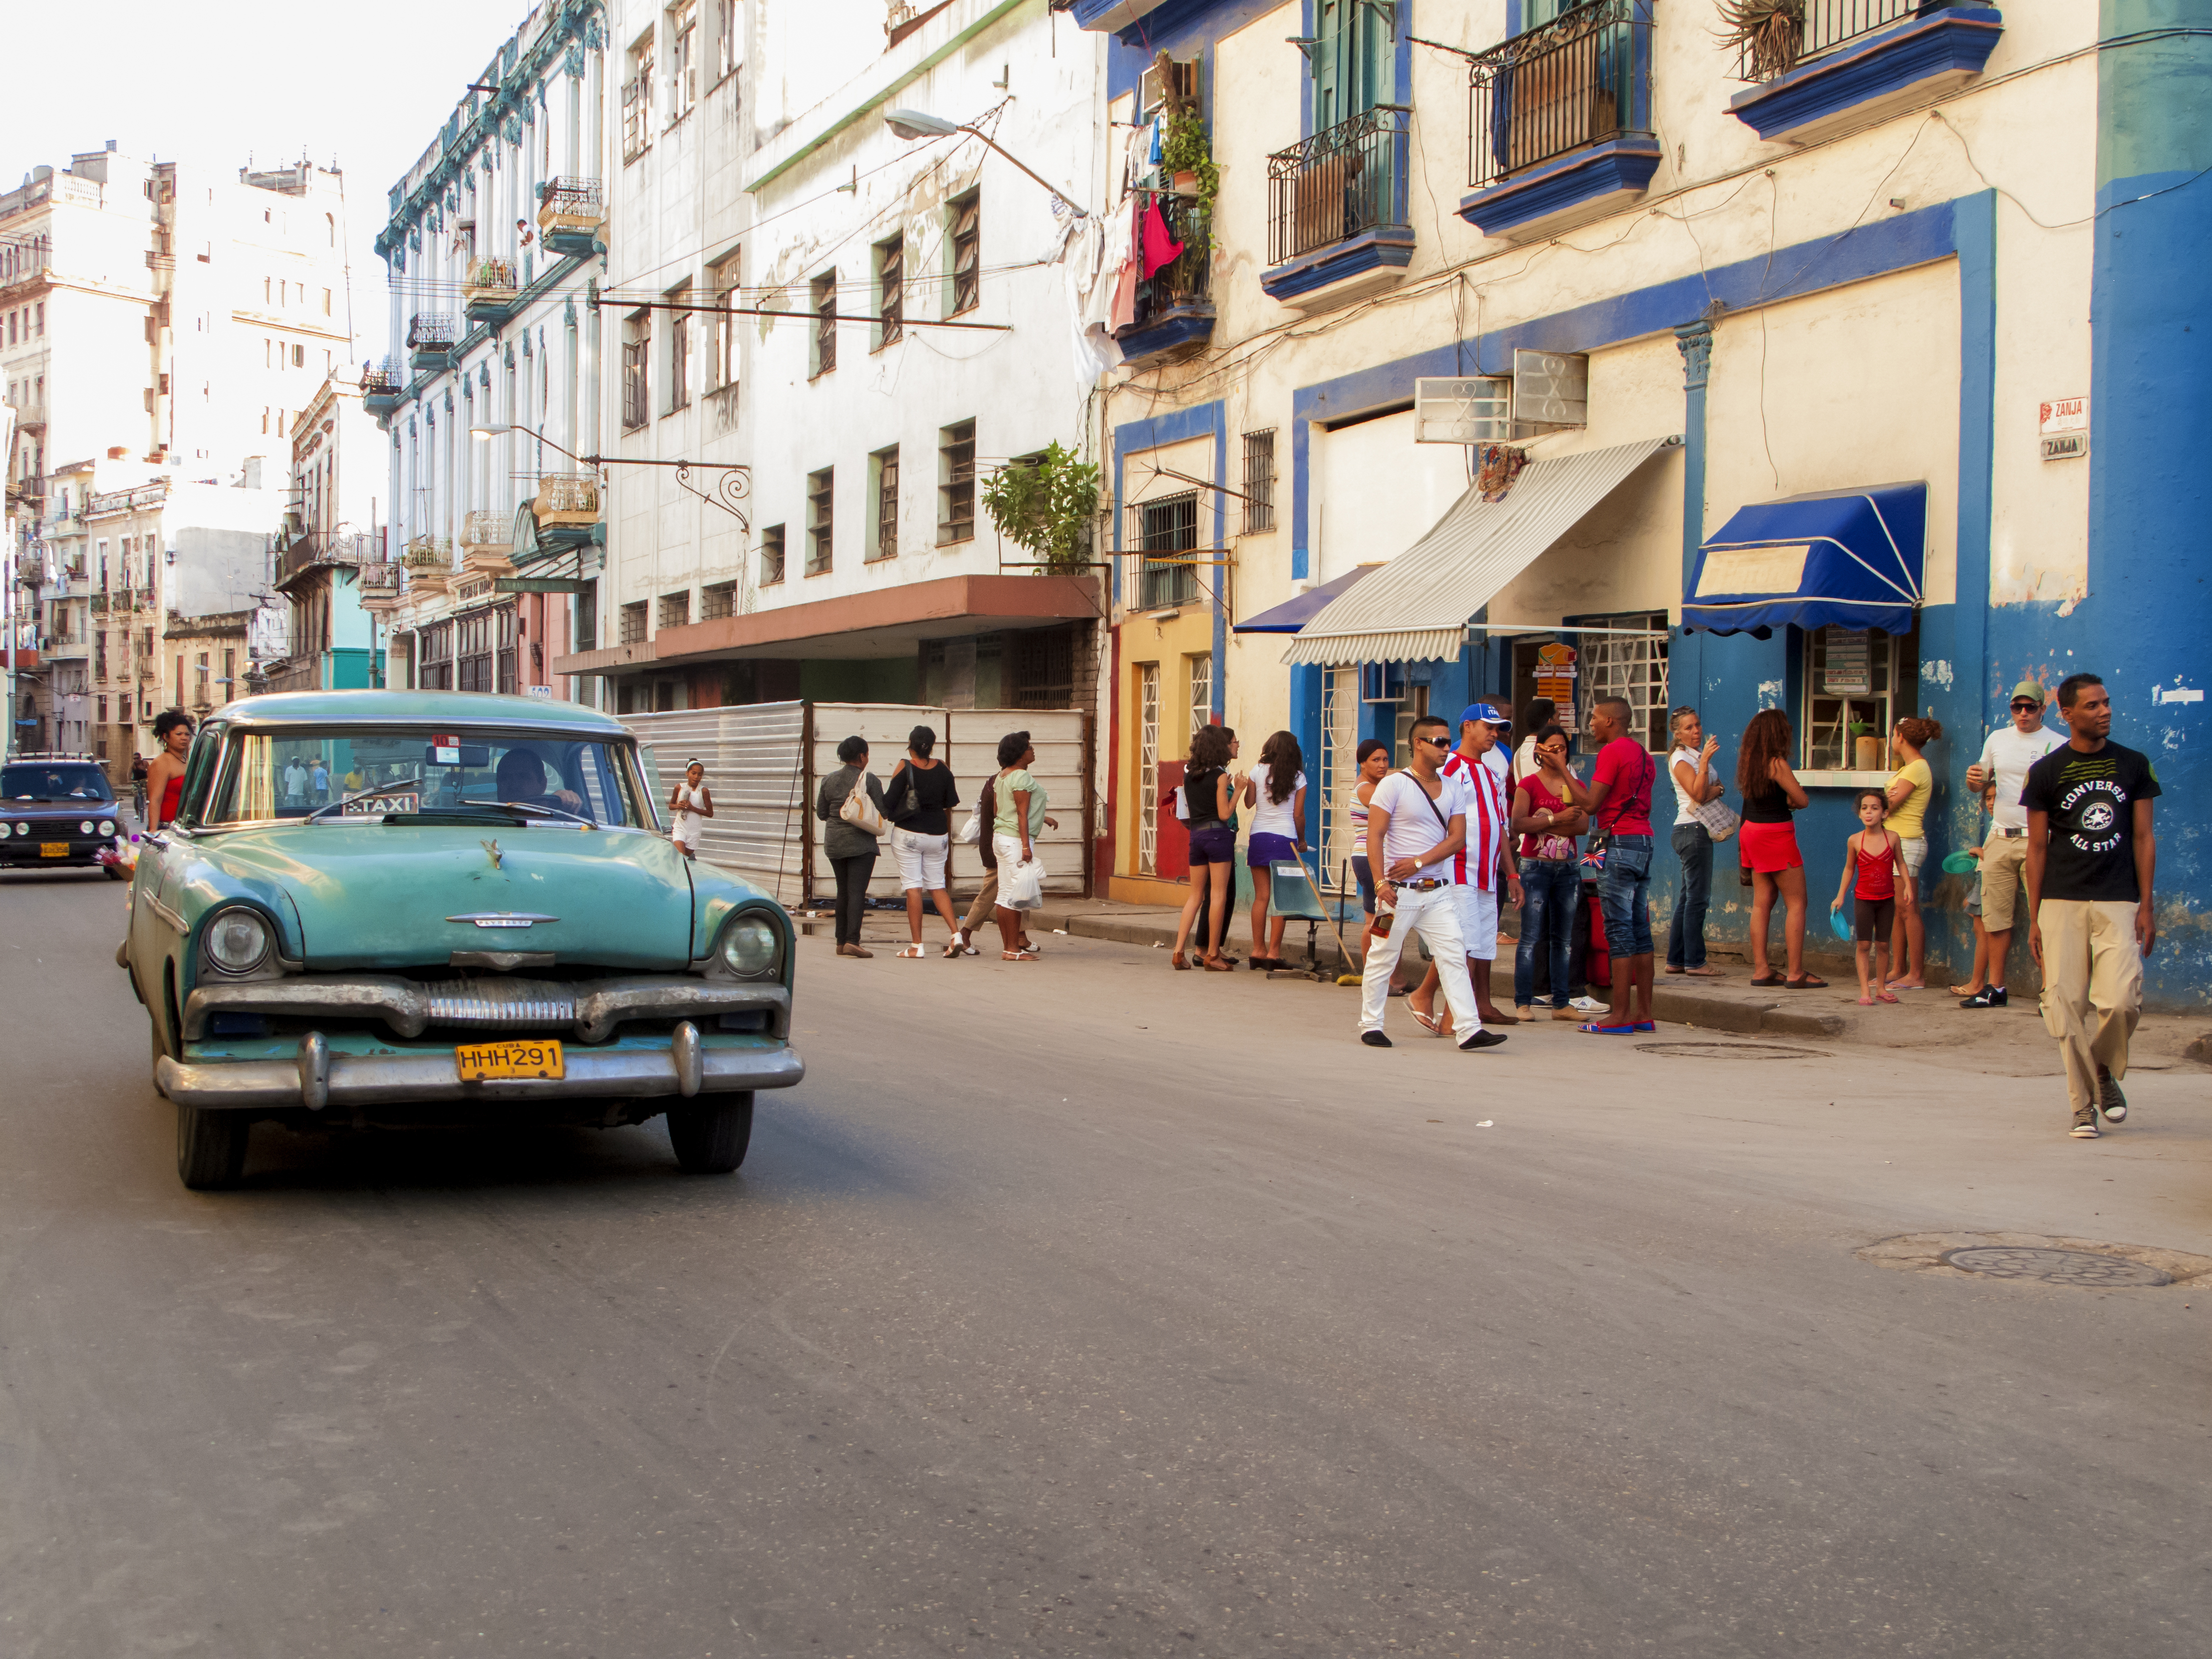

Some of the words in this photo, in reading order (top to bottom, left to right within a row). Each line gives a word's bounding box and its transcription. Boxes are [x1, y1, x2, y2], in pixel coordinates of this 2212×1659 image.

[2056, 401, 2082, 417] ZANJA
[2047, 438, 2078, 456] ZANJA
[434, 736, 449, 746] 10
[359, 797, 410, 812] TAXI
[2061, 781, 2126, 810] CONVERSE
[2070, 834, 2089, 851] ALL
[2093, 832, 2122, 852] STAR
[460, 1048, 557, 1068] HHH291
